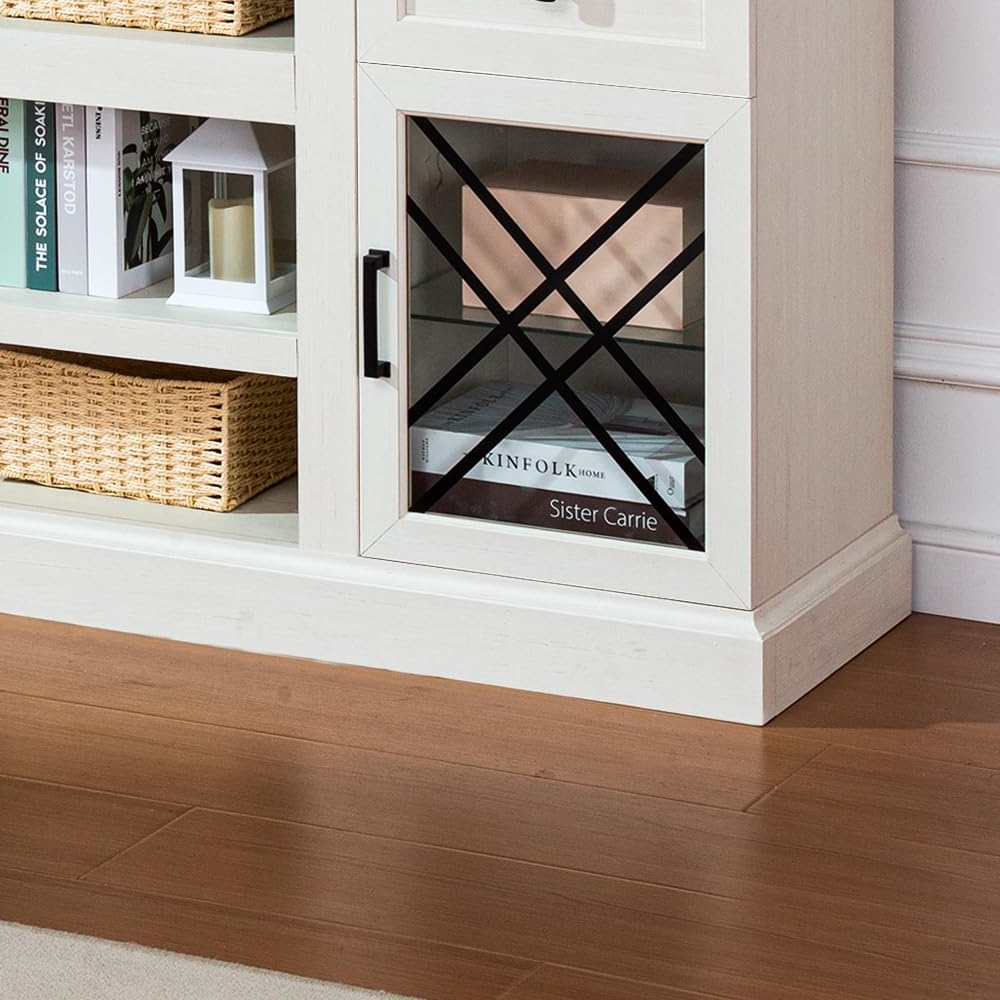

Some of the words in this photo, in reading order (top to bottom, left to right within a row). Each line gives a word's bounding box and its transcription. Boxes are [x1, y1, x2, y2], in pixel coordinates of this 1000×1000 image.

[34, 152, 46, 173] OF
[35, 178, 47, 237] SOLACE
[35, 243, 48, 272] THE
[482, 452, 578, 479] KINFOLK
[578, 468, 606, 480] HOME
[550, 499, 599, 523] Sister
[604, 506, 658, 531] Carrie
